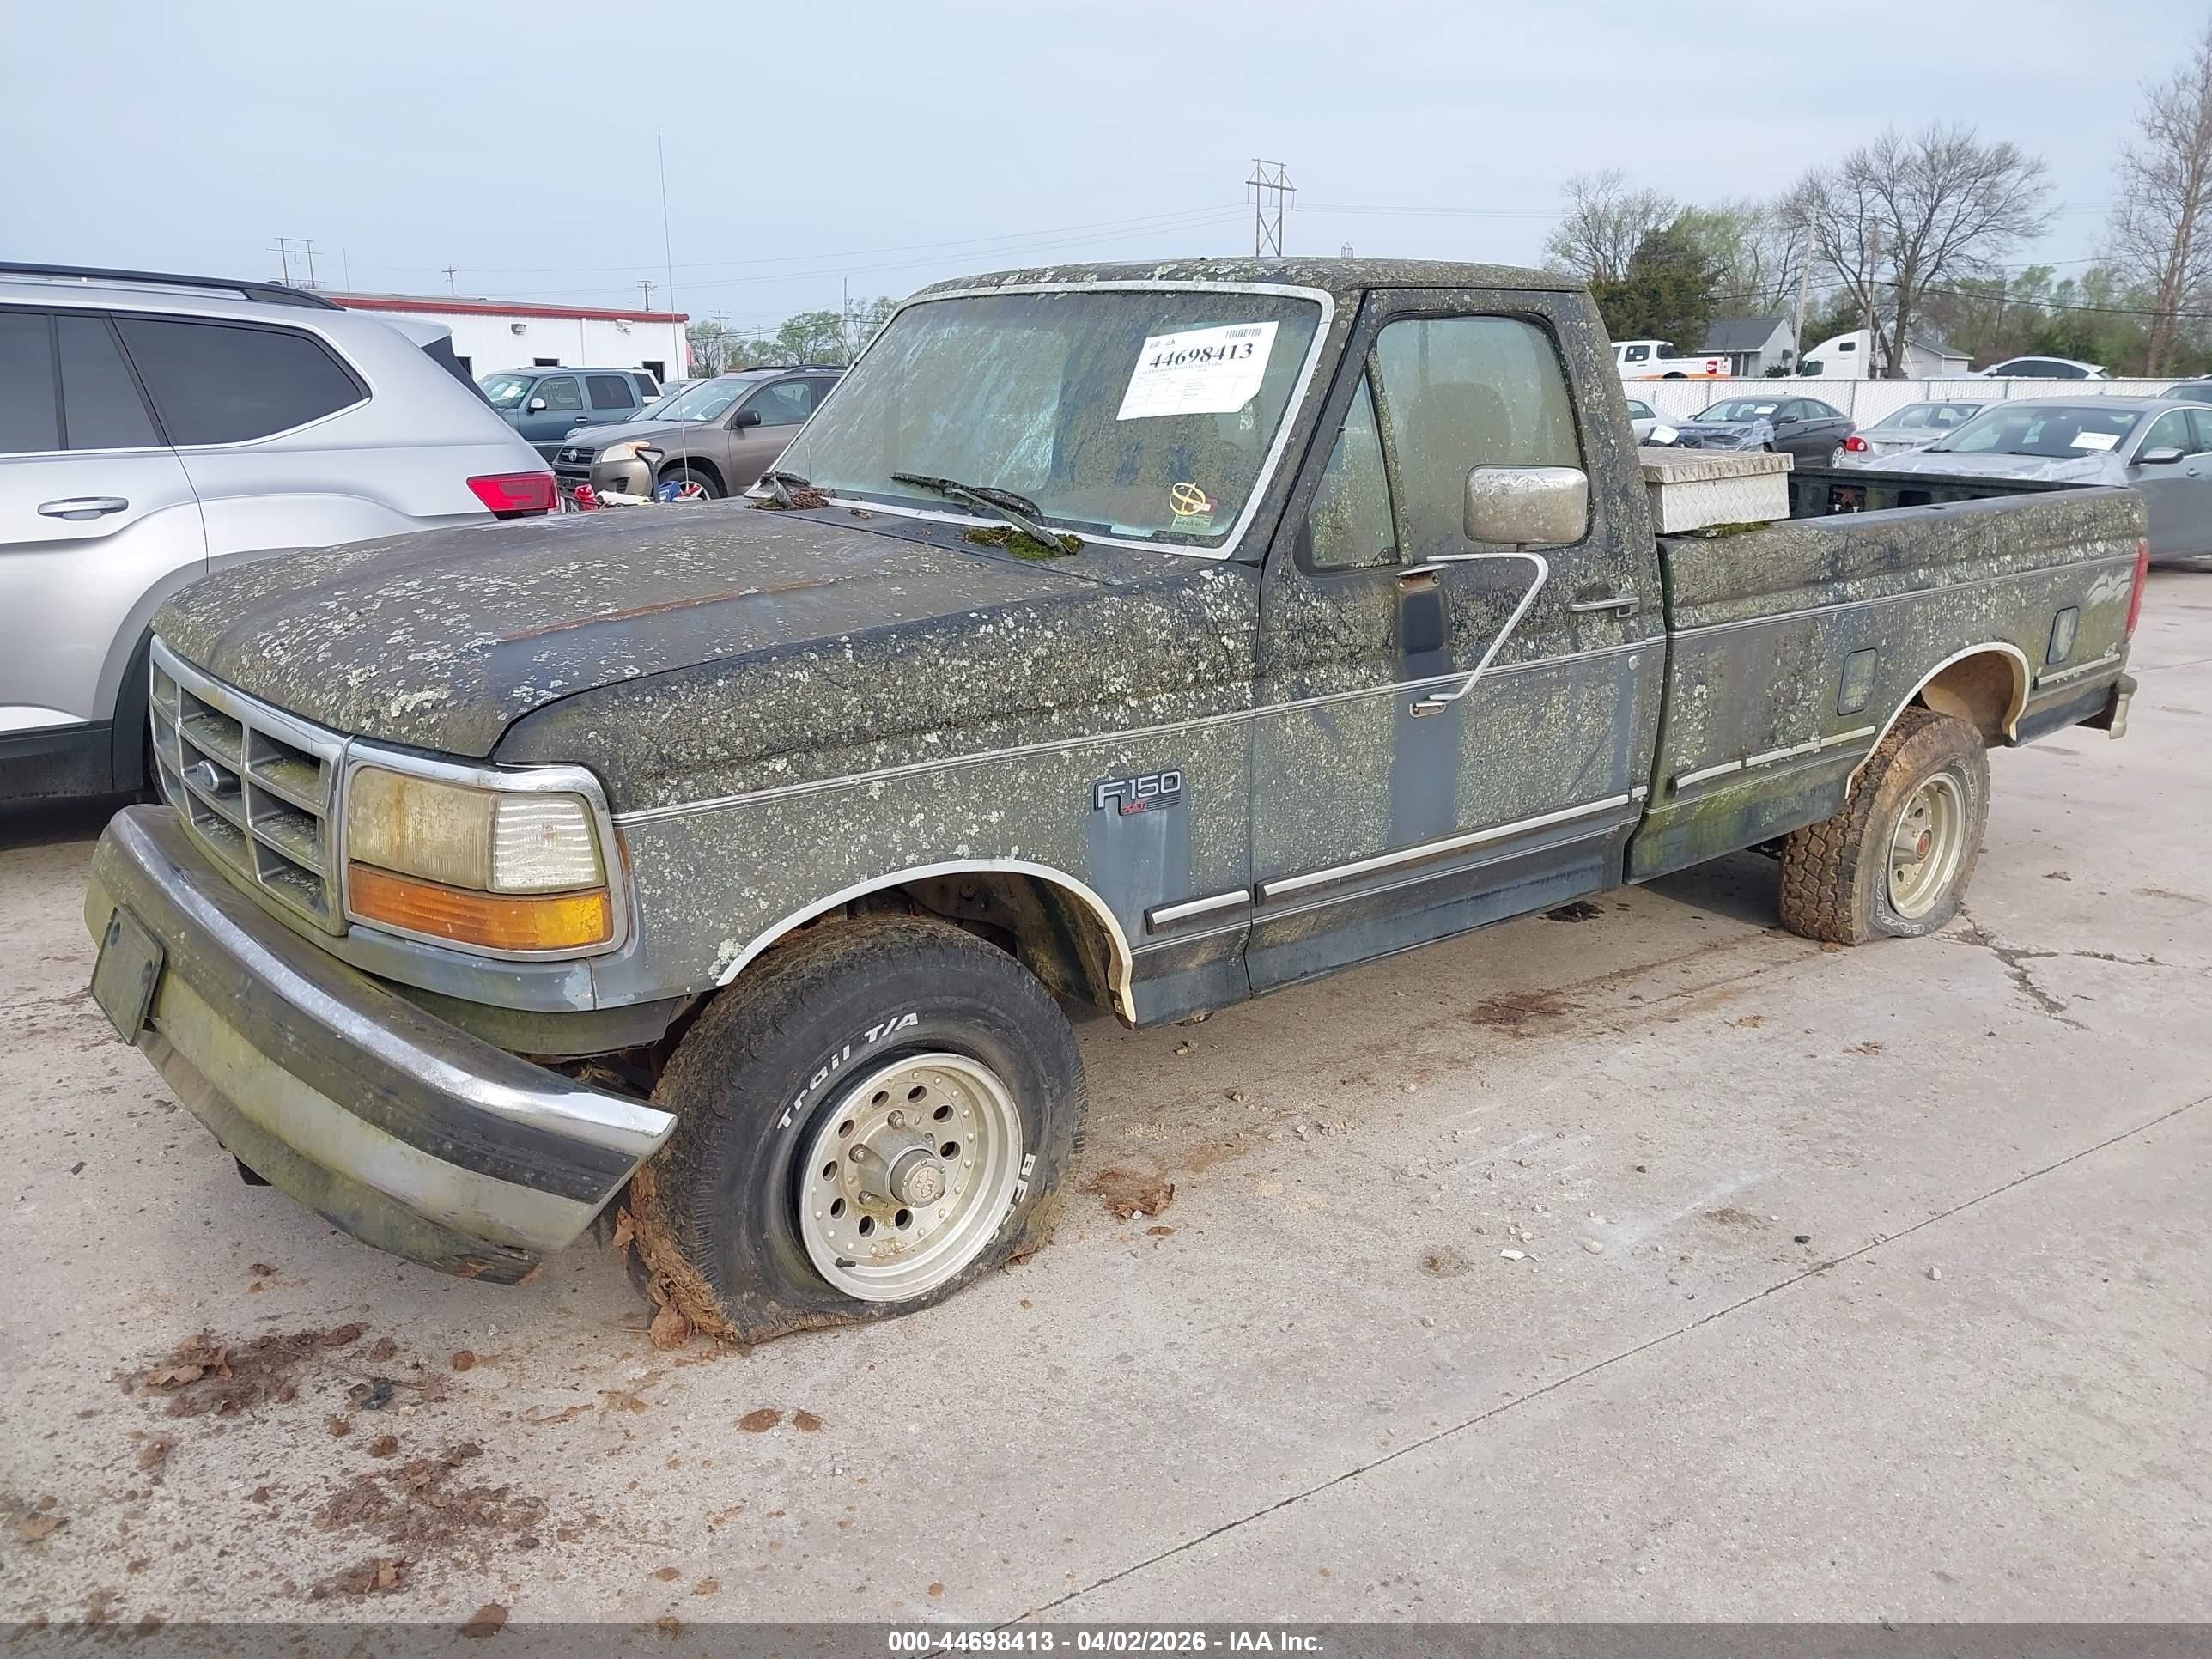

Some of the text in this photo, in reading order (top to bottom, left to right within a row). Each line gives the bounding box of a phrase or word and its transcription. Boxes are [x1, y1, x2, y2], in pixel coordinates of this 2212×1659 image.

[1149, 343, 1254, 368] 44698413
[776, 1012, 919, 1130] Trail T/A
